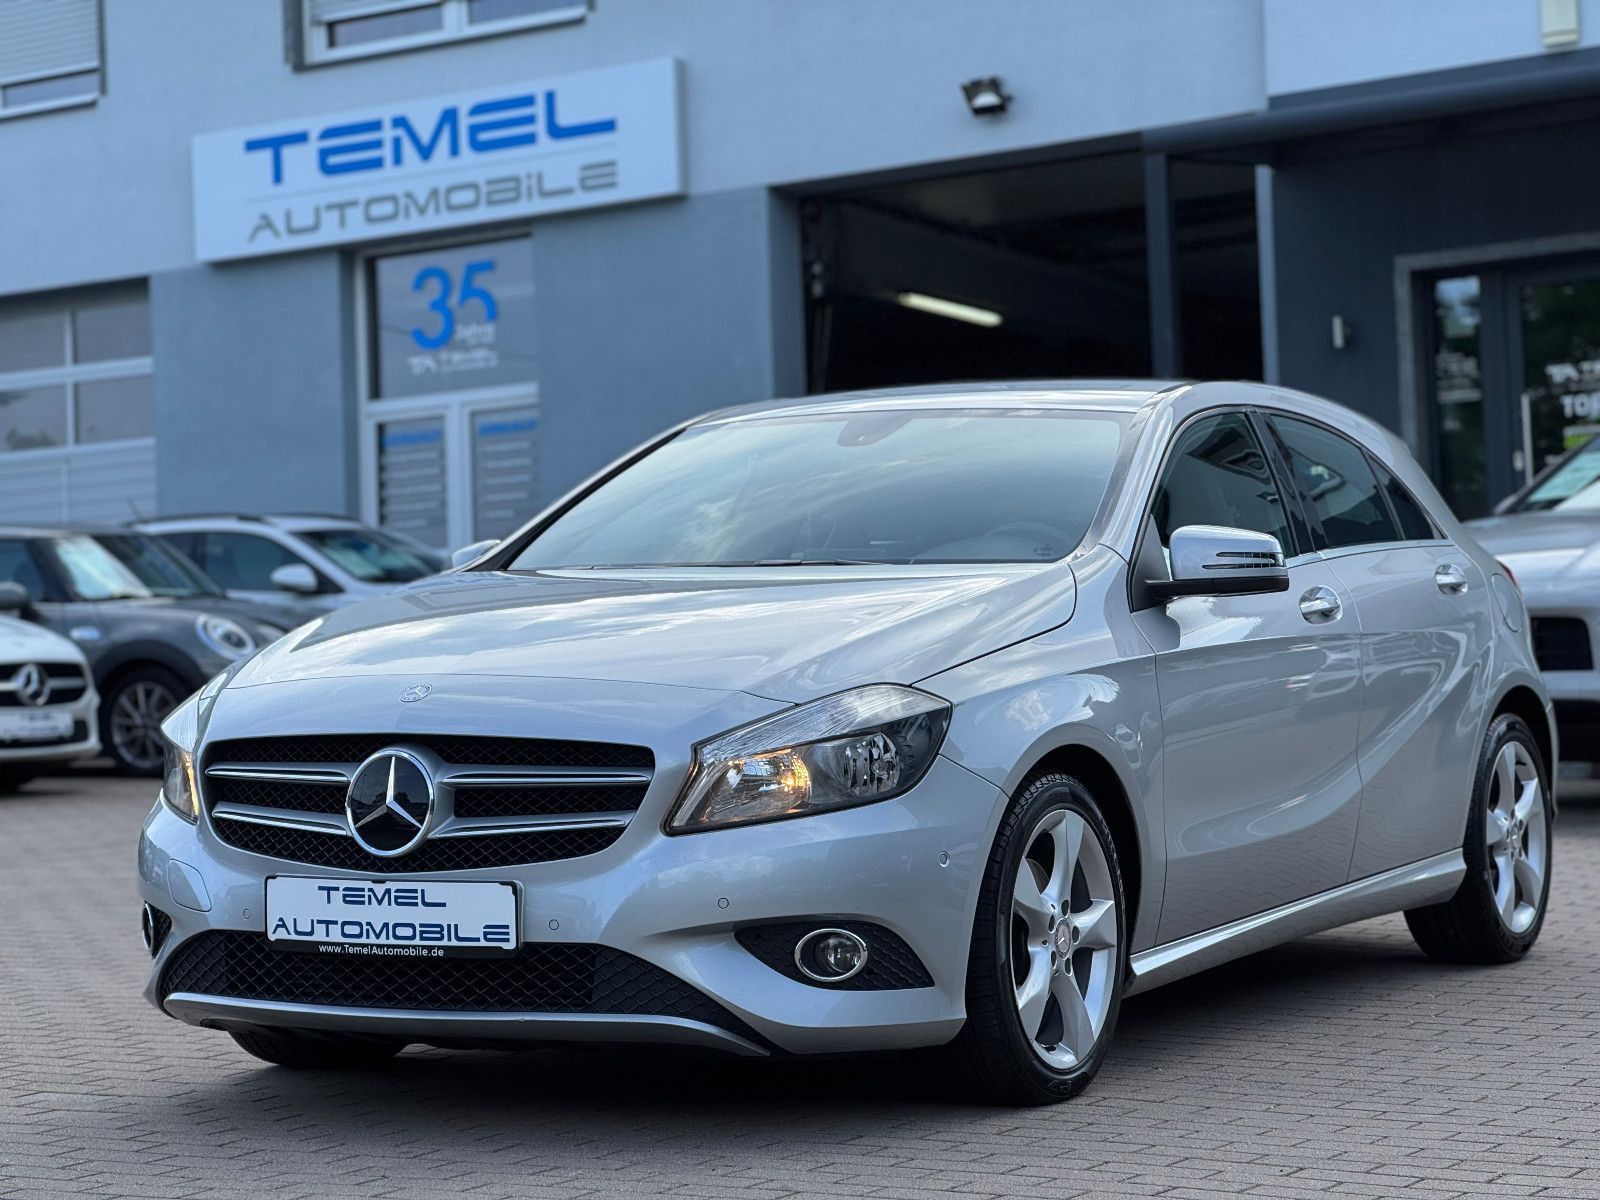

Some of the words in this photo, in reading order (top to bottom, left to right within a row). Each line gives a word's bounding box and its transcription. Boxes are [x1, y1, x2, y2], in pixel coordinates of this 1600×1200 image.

[244, 90, 618, 185] TEMEL
[411, 259, 498, 351] 35
[317, 885, 447, 908] TEMEL
[271, 916, 511, 943] AUTOMOBILE
[318, 944, 444, 957] www.TemelAutomobile.de
